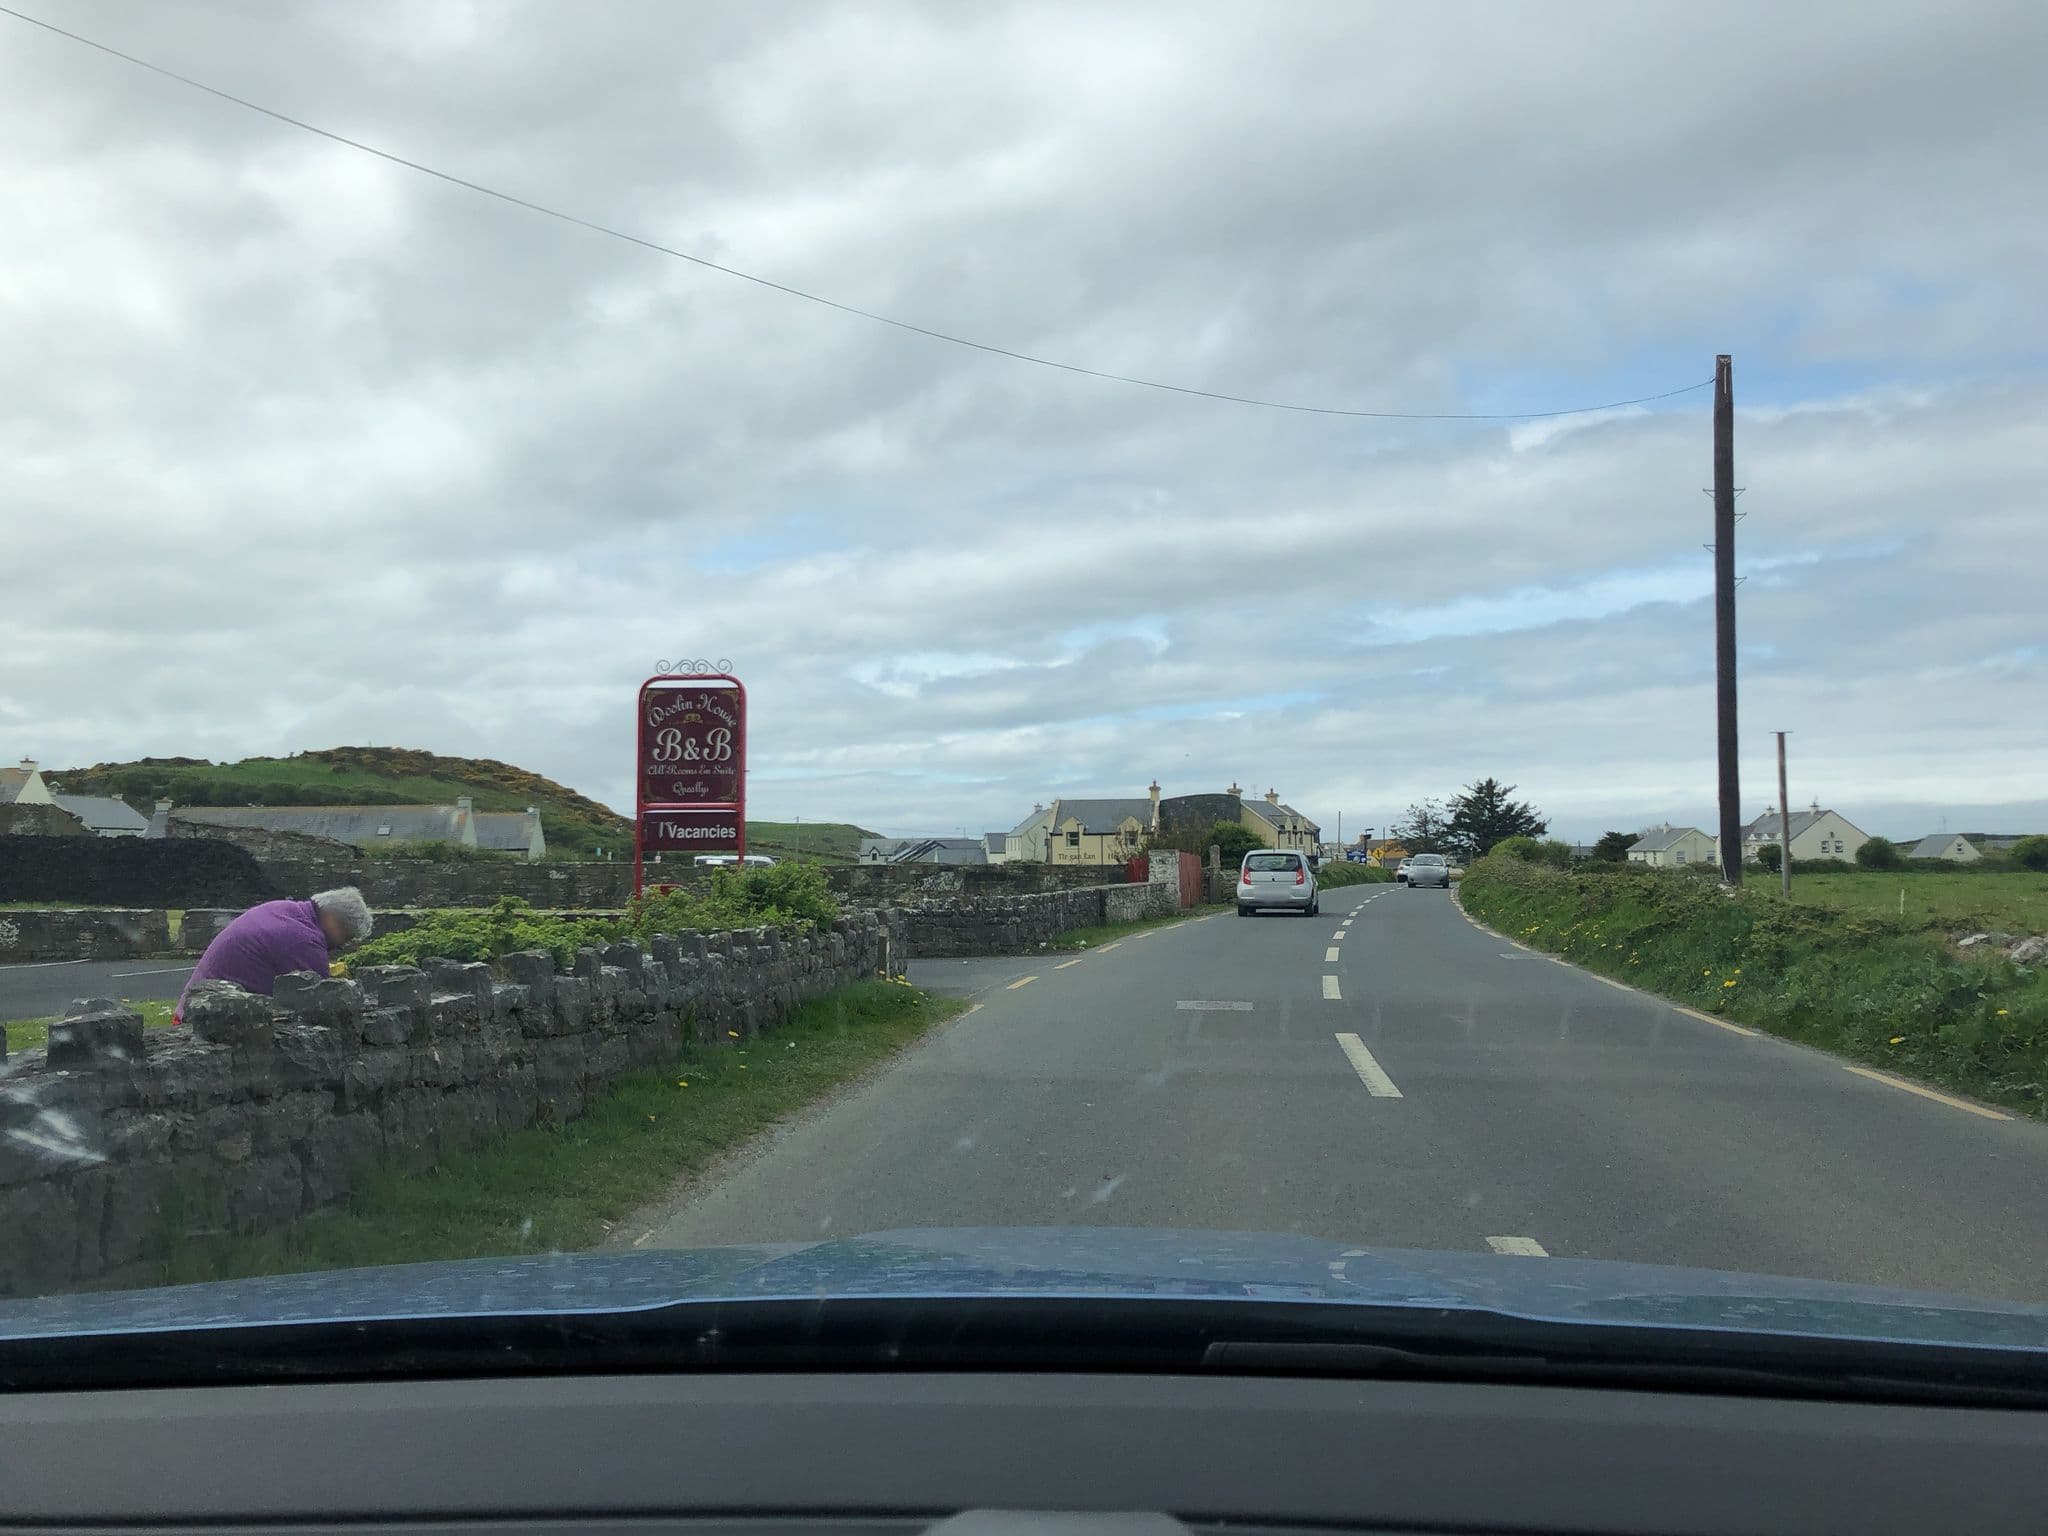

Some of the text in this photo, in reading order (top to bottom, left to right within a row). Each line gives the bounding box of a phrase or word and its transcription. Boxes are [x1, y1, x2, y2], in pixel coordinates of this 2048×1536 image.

[650, 693, 737, 727] Doolin House
[653, 728, 732, 761] B&B
[648, 765, 665, 775] All
[666, 765, 698, 775] Rooms
[713, 765, 735, 775] Suite
[668, 824, 736, 838] Vacancies
